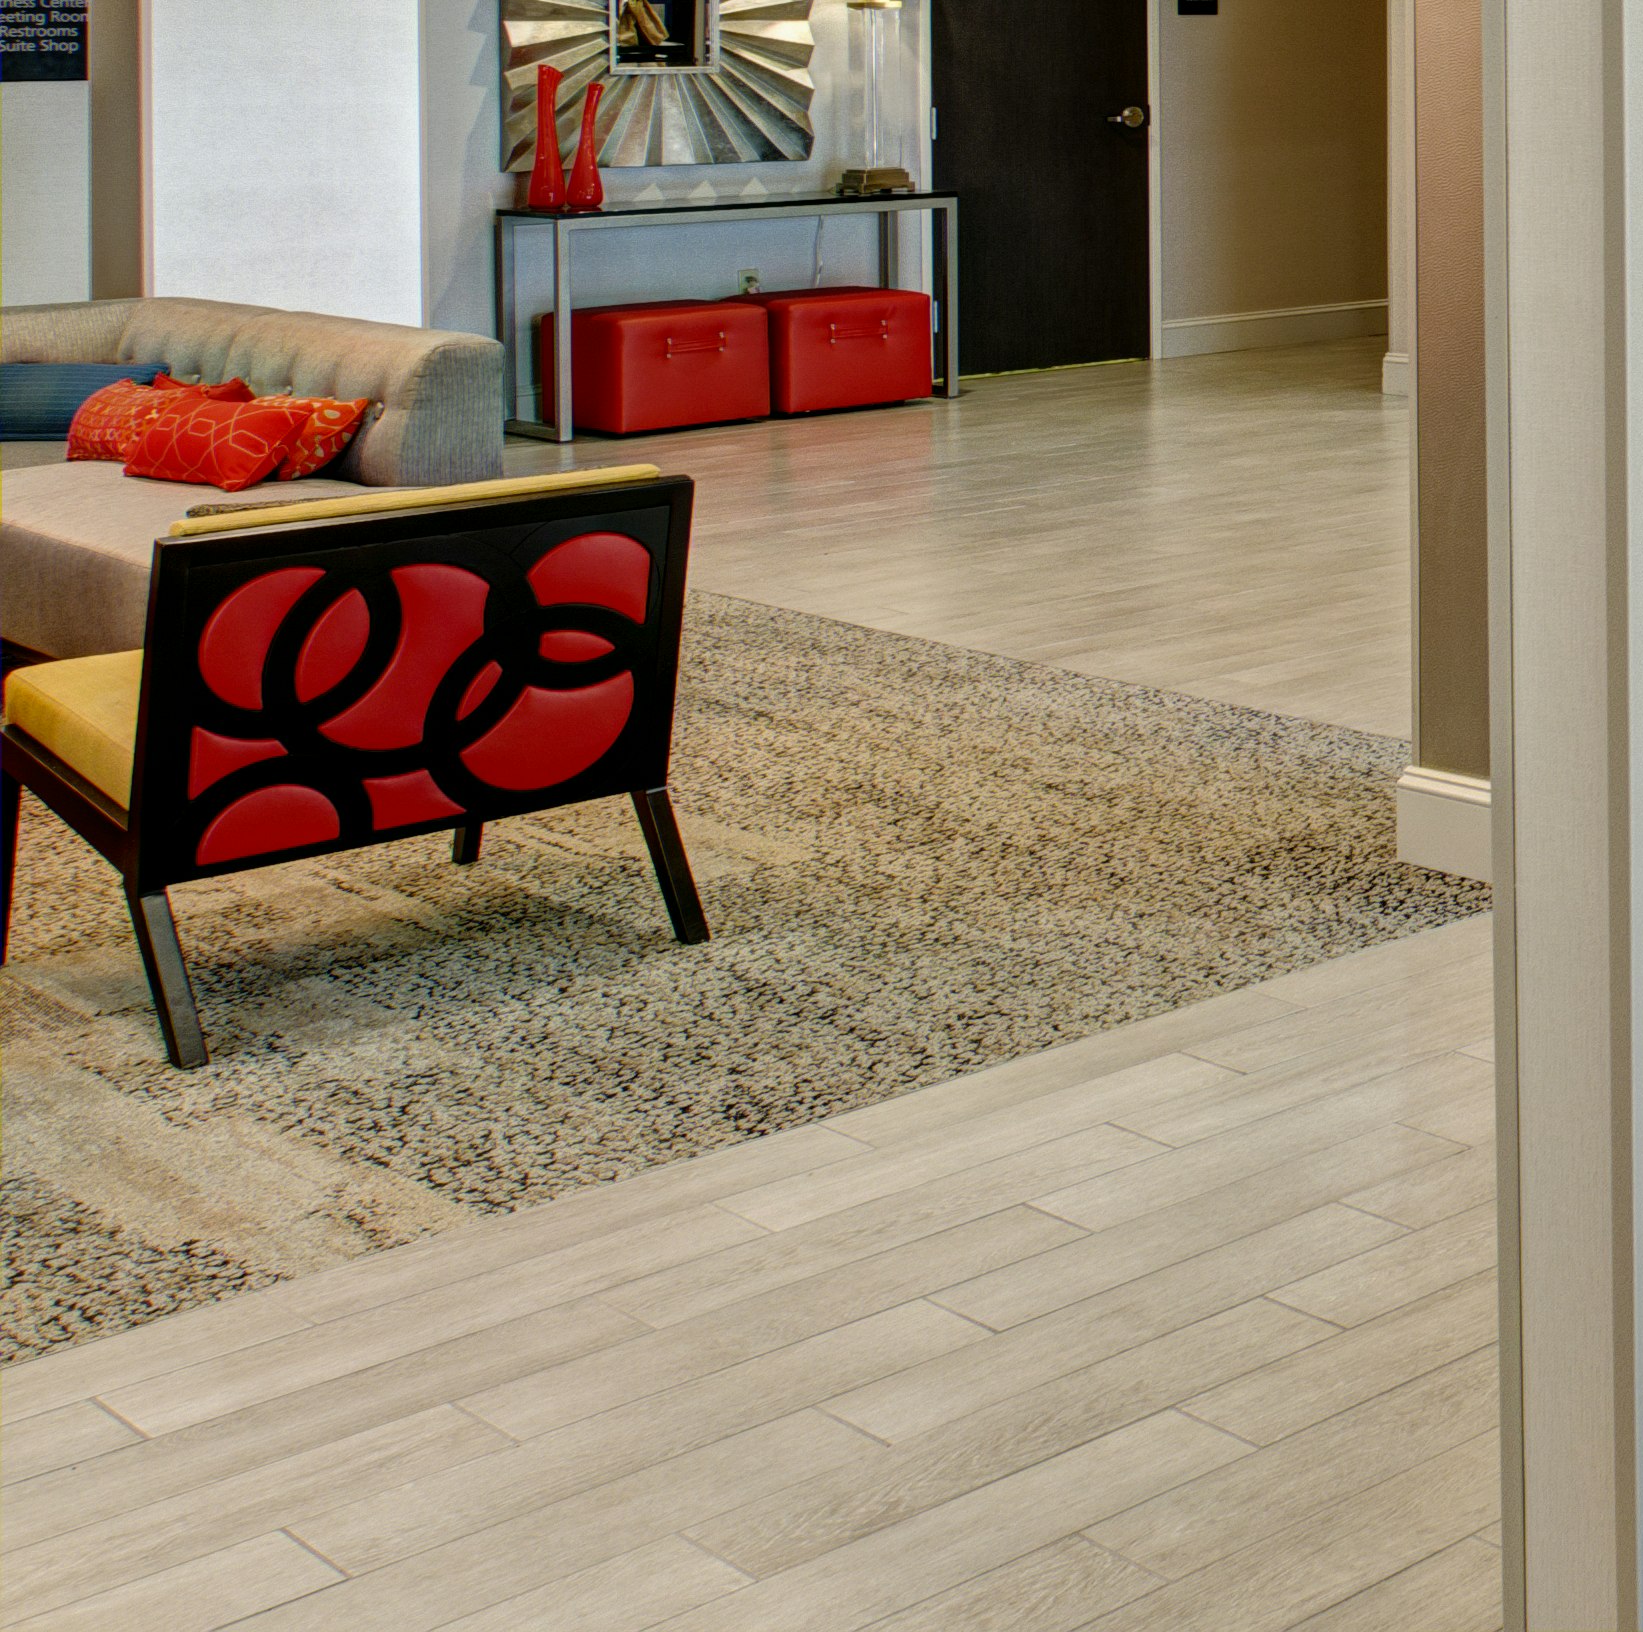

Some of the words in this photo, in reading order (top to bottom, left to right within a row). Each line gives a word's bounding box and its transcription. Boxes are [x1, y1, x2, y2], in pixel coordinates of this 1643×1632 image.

[0, 25, 79, 37] Restrooms
[0, 39, 36, 52] Suite
[40, 39, 80, 55] Shop
